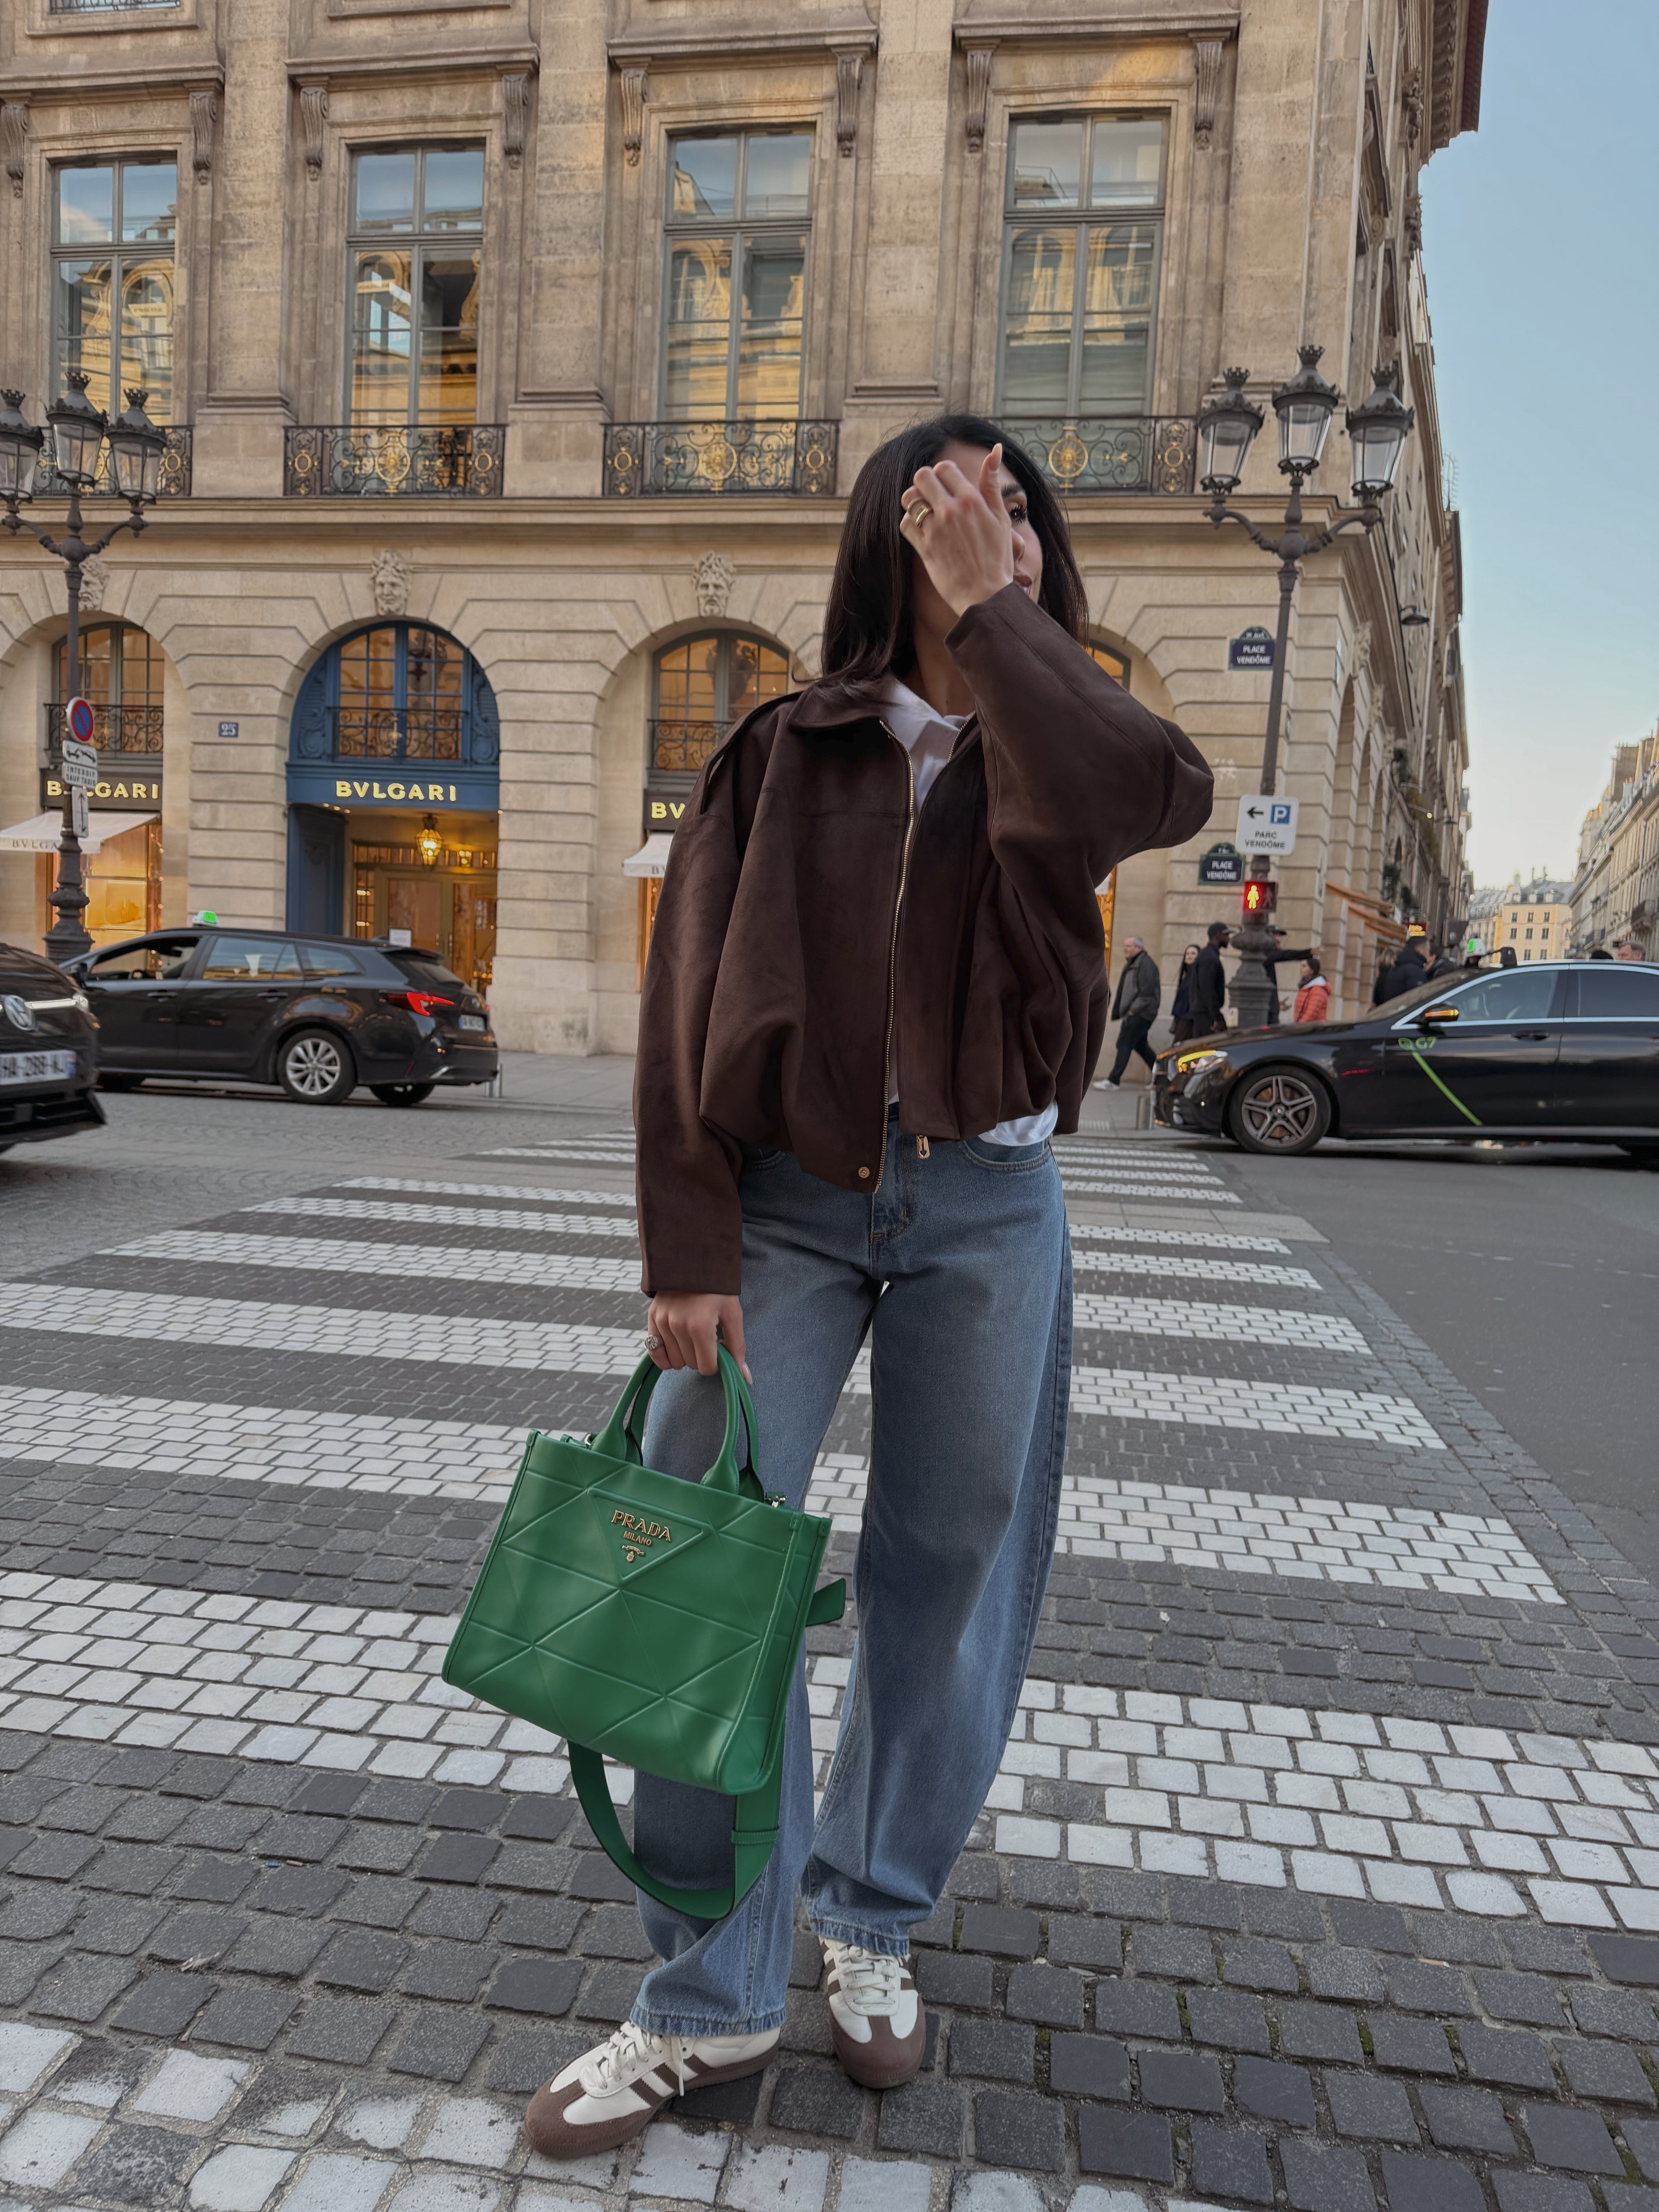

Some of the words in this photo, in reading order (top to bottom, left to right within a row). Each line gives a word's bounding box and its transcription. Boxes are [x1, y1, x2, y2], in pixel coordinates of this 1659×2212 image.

[1243, 645, 1266, 654] PLACE
[1236, 654, 1271, 664] VENDÔME
[221, 723, 236, 736] 25
[67, 766, 95, 778] INTERDIT
[66, 773, 79, 782] SAUF
[82, 777, 96, 785] TAXIS
[47, 780, 158, 799] BGARI
[336, 781, 456, 801] BVLGARI
[1273, 807, 1287, 823] P
[1255, 830, 1277, 839] PARC
[1245, 839, 1286, 849] VENDÔME
[1211, 861, 1233, 870] PLACE
[1206, 870, 1237, 880] VENDÔME
[611, 1510, 671, 1542] PRADA
[623, 1531, 652, 1546] MILANO
